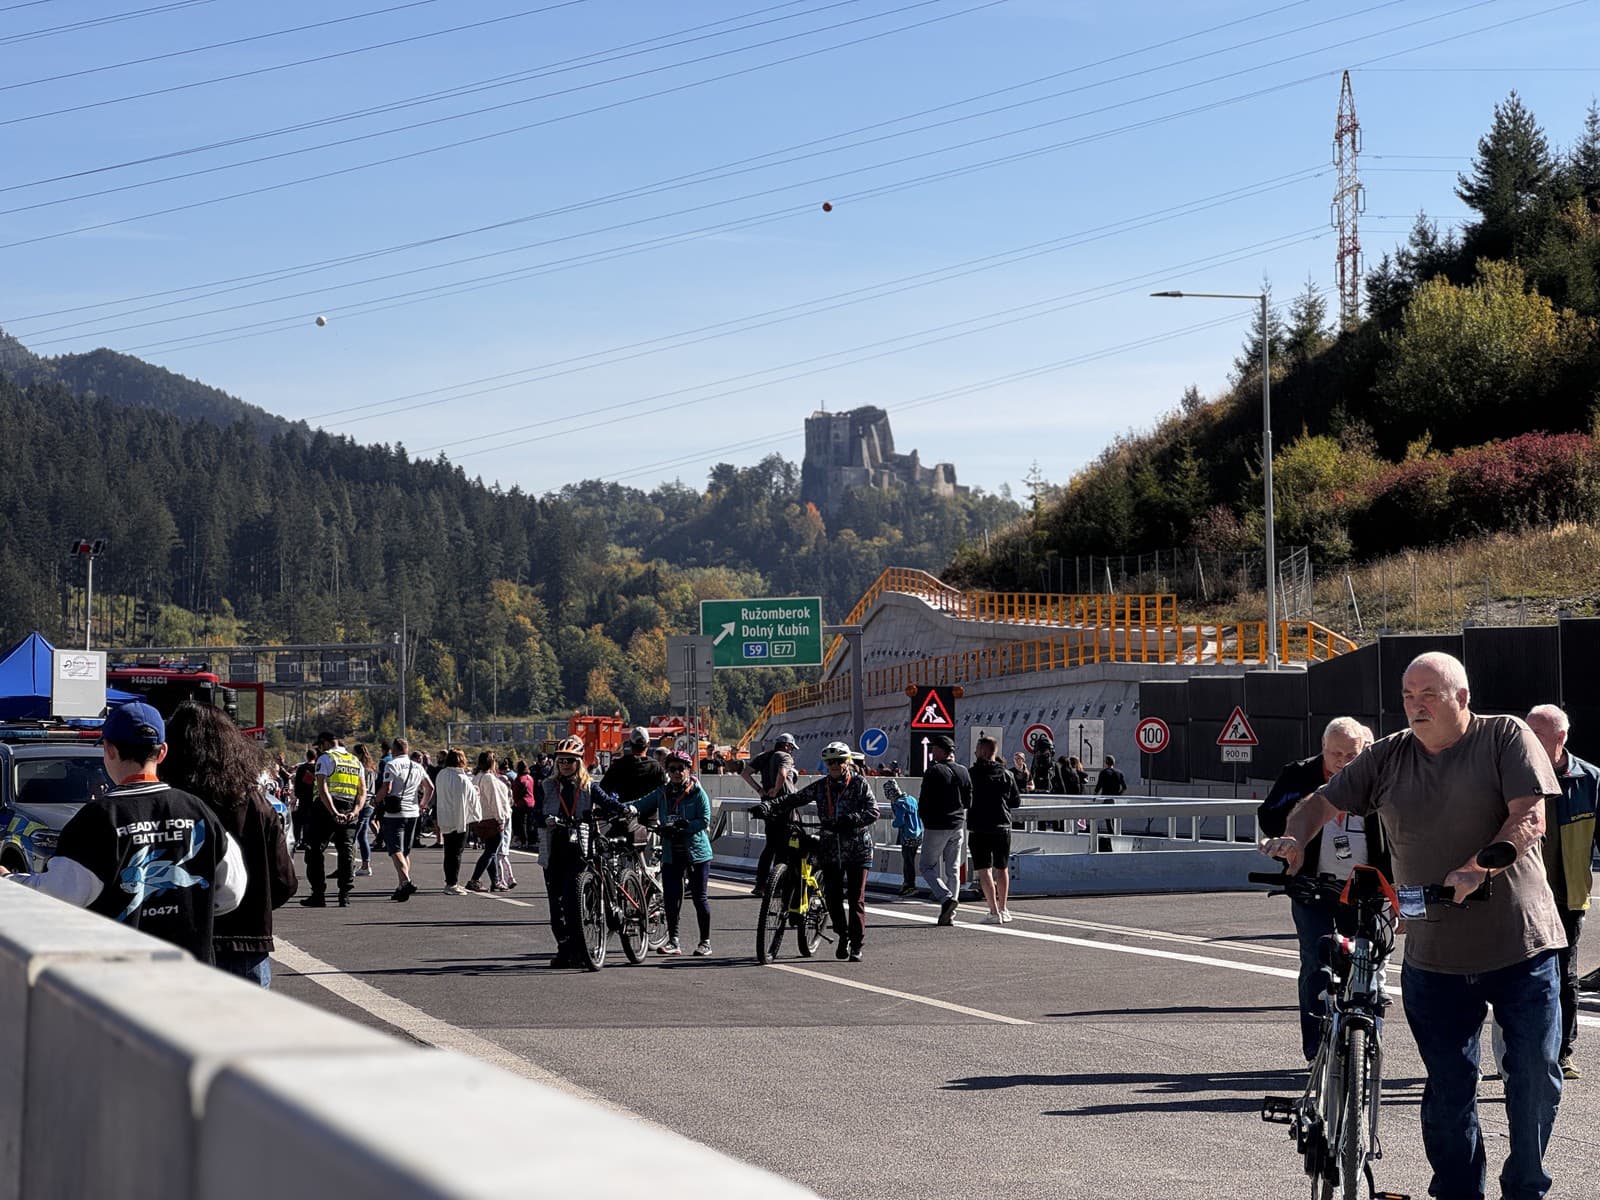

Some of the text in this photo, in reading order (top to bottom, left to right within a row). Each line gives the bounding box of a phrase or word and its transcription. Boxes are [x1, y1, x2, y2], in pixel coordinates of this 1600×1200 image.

[741, 607, 811, 621] Ružomberok
[741, 623, 809, 639] Dolný Kubín
[749, 644, 792, 655] 59 E77
[1142, 727, 1163, 743] 100
[116, 818, 195, 837] READY FOR
[133, 830, 183, 845] BATTLE
